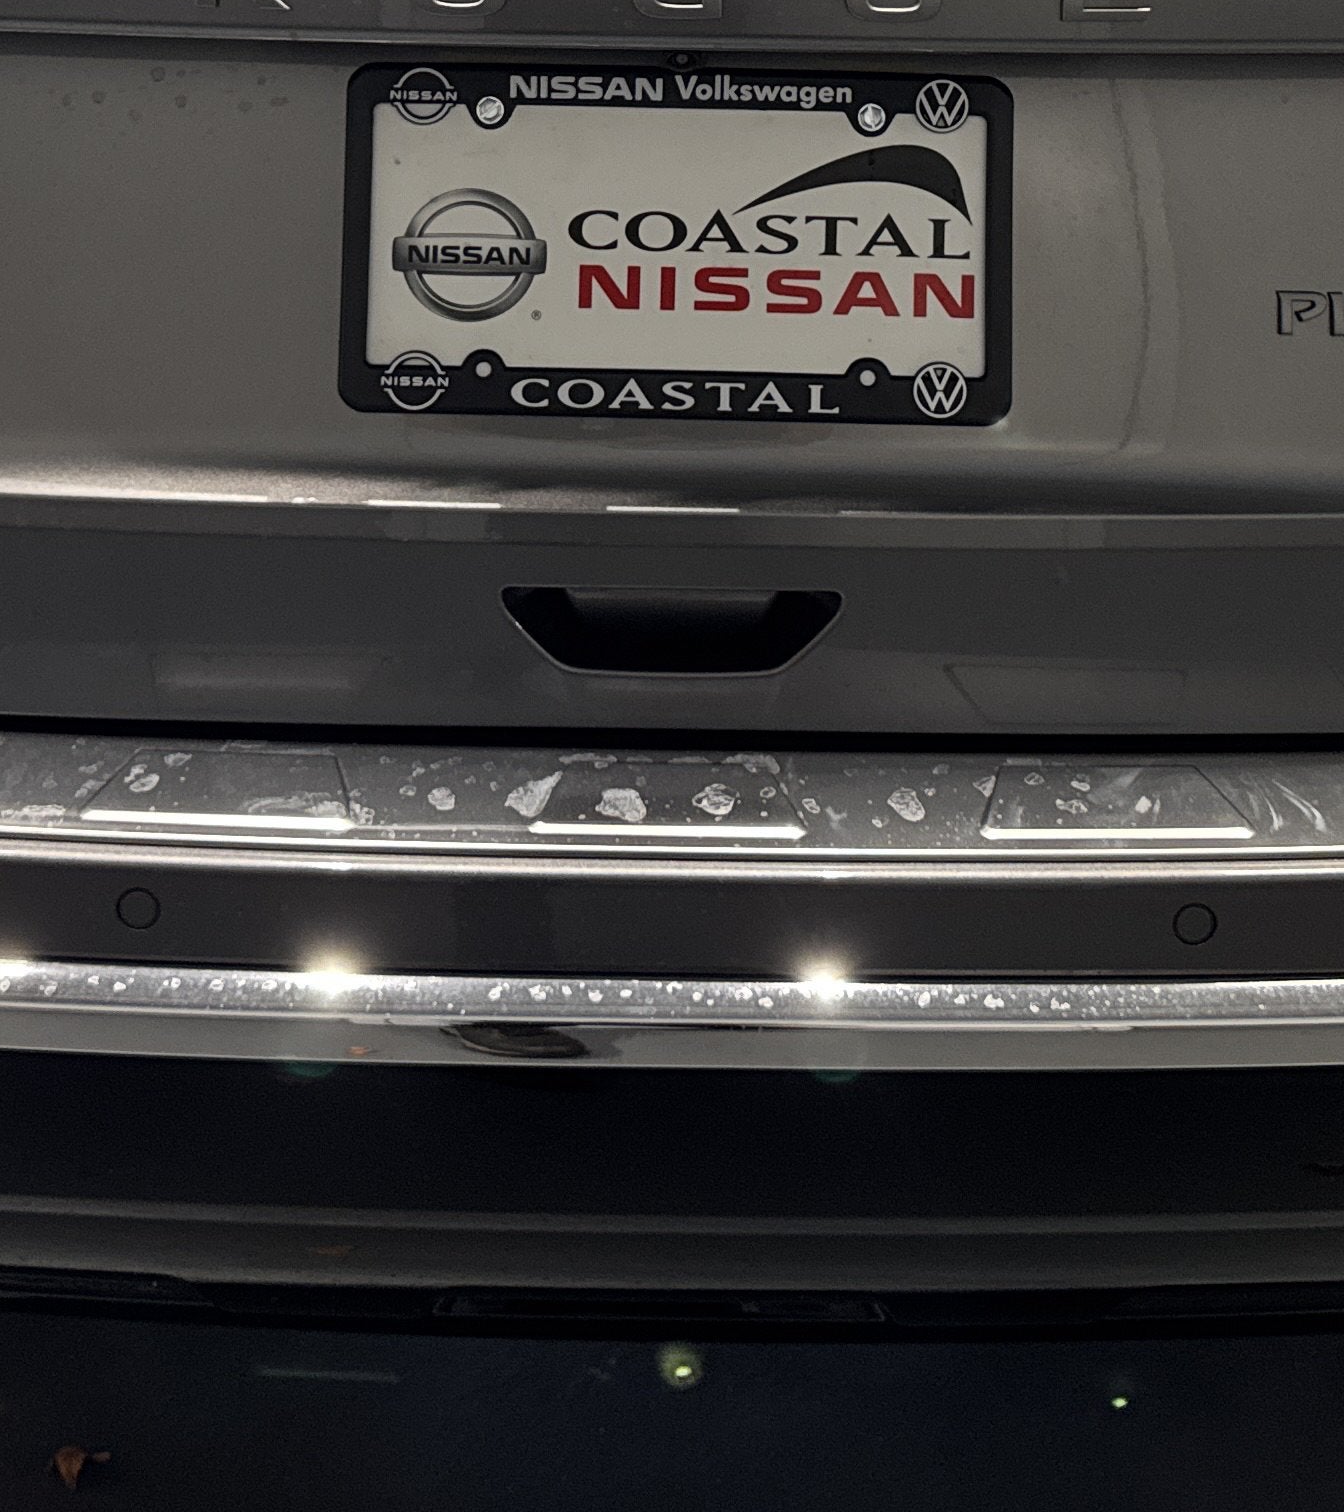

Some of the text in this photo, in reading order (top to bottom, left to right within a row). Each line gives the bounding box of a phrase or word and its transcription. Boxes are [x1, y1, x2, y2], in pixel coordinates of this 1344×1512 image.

[389, 89, 458, 101] NISSAN
[509, 74, 853, 106] NISSAN Volkswagen
[567, 207, 972, 261] COASTAL
[407, 244, 532, 267] NISSAN
[576, 264, 976, 320] NISSAN
[380, 375, 449, 388] NISSAN
[510, 377, 841, 415] COASTAL
